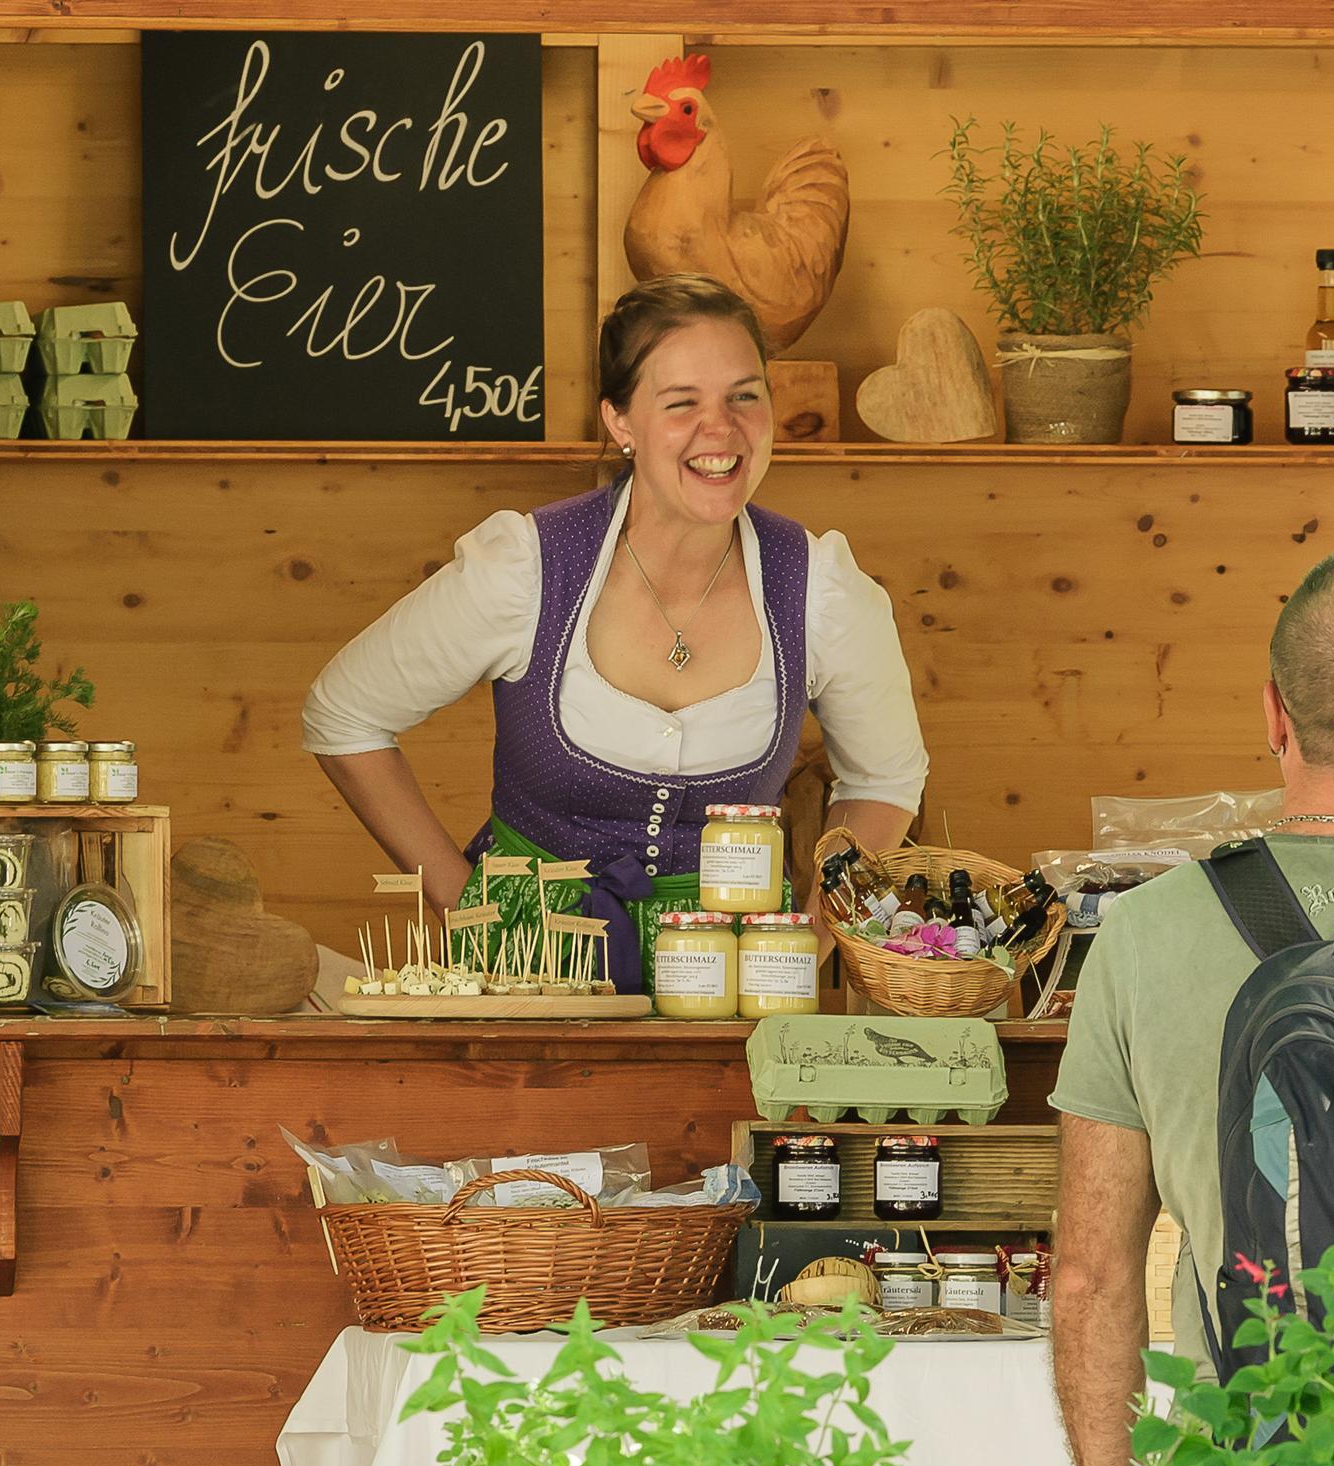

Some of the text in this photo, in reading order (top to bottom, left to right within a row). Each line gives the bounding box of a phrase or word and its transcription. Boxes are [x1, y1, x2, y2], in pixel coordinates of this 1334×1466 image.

[170, 40, 509, 271] frische
[217, 219, 455, 367] Eier
[418, 361, 543, 431] 4,50€
[702, 845, 762, 855] UTTERSCHMALZ
[657, 955, 717, 964] UTTERSCHMALZ
[744, 954, 812, 965] BUTTERSCHMALZ
[882, 1285, 923, 1296] räutersalz
